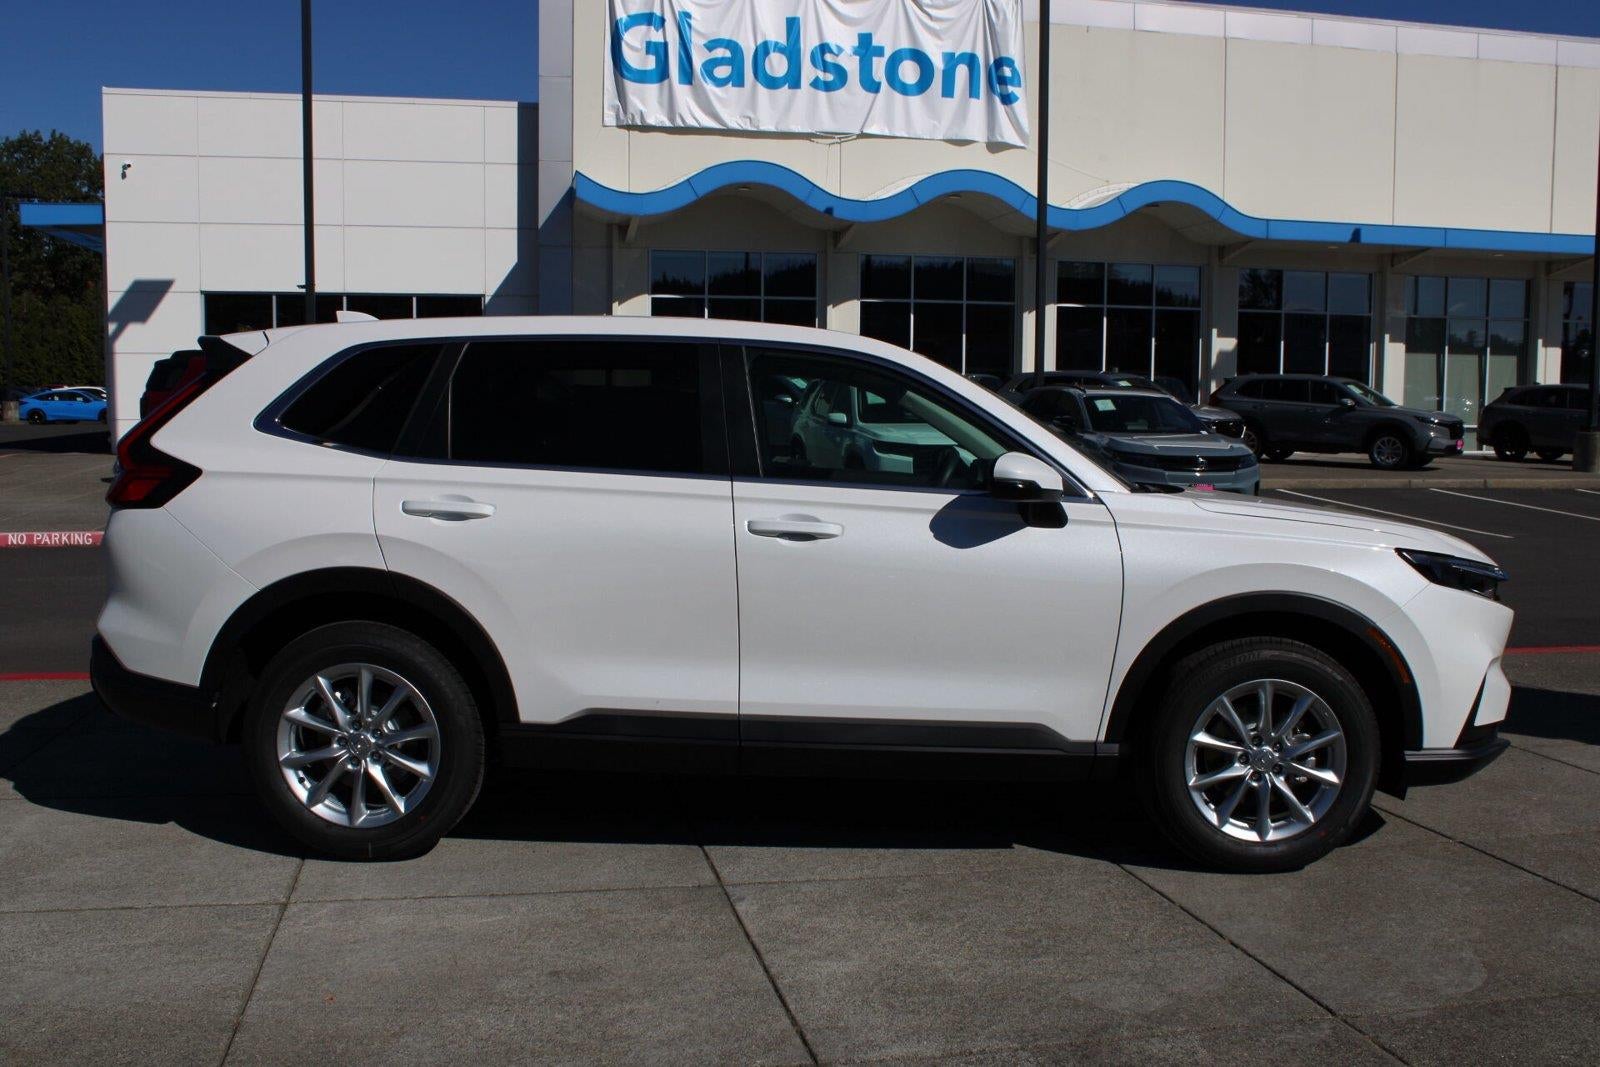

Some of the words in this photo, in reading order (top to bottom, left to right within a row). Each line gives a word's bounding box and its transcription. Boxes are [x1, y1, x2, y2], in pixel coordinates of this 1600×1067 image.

[611, 11, 1022, 106] Gladstone
[8, 533, 27, 545] NO
[33, 533, 93, 545] PARKING
